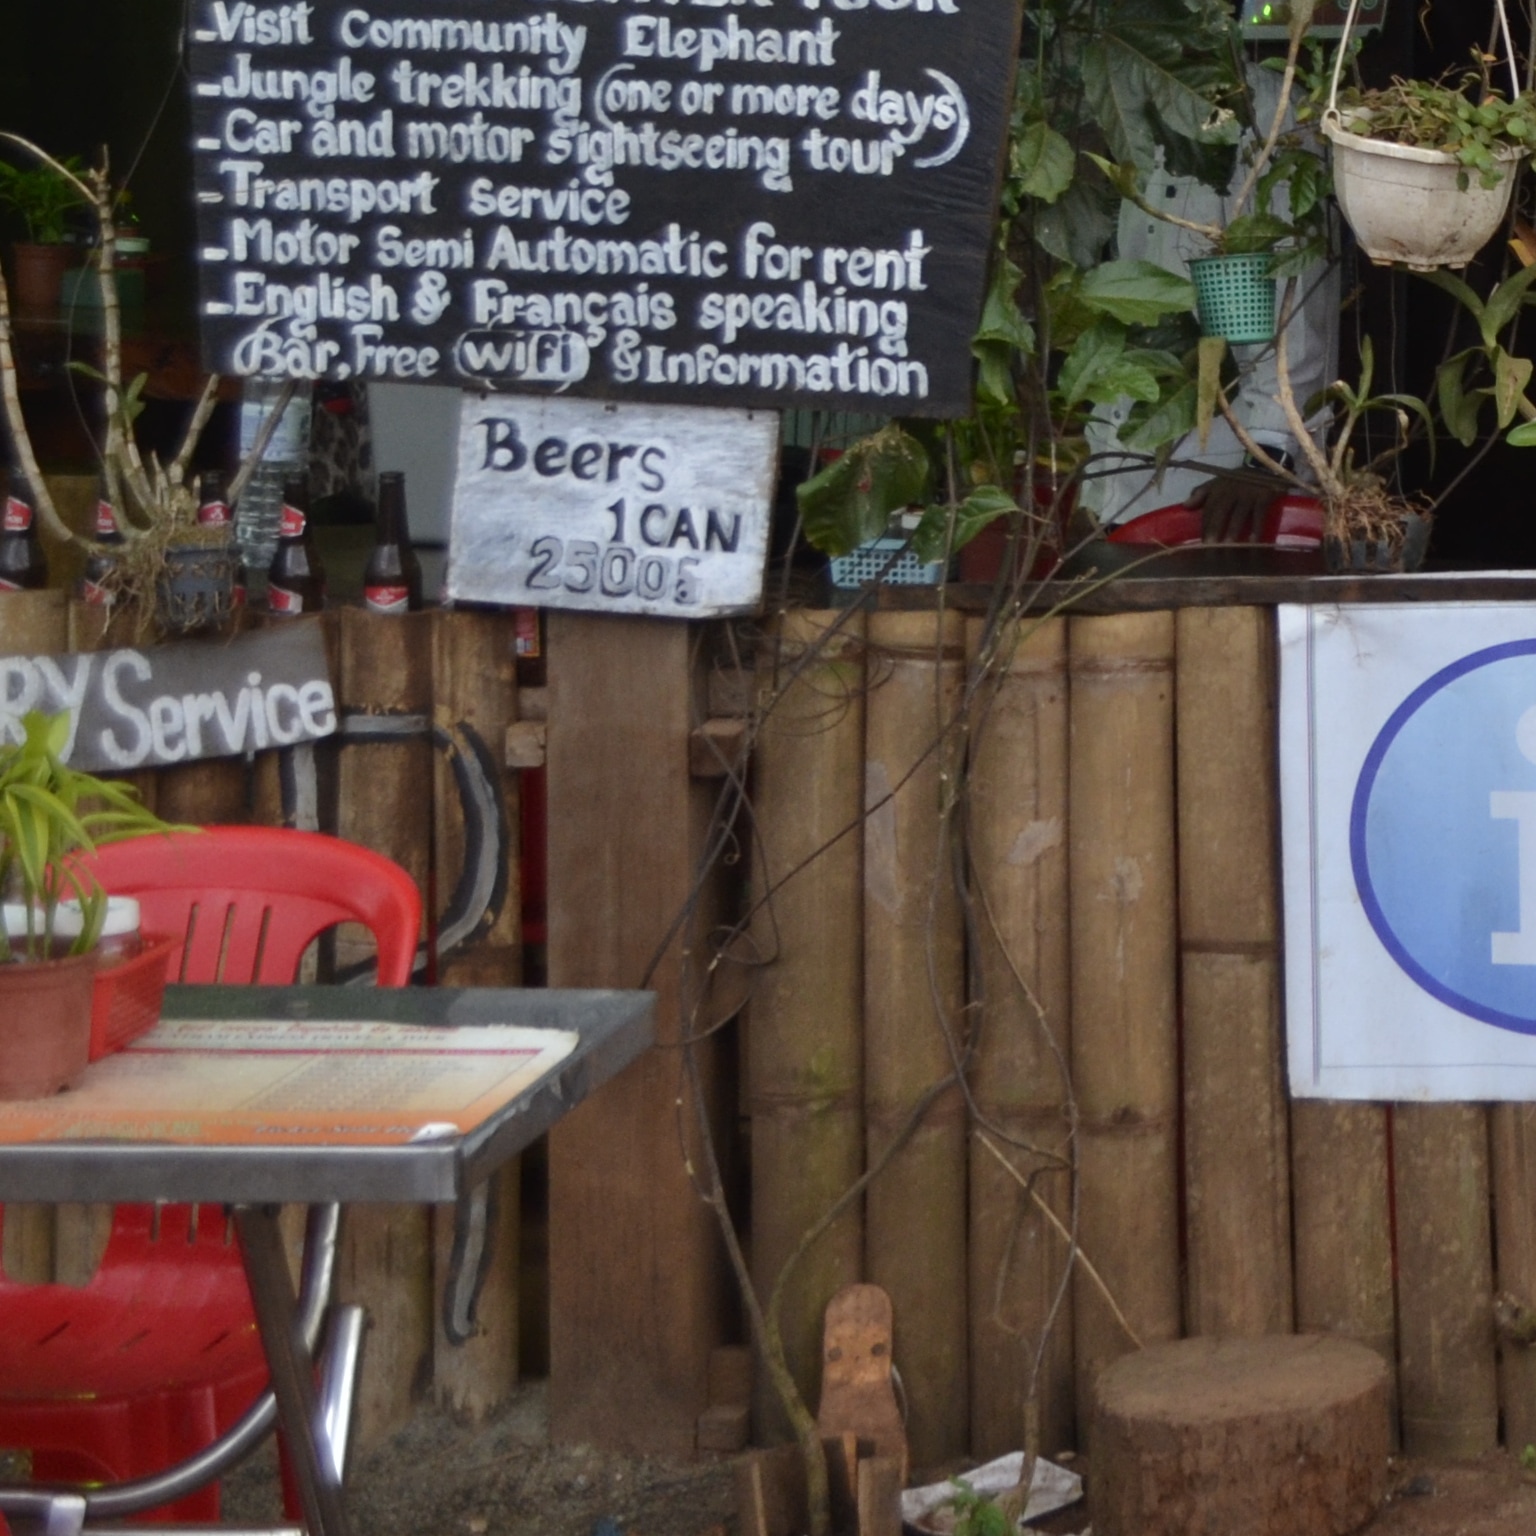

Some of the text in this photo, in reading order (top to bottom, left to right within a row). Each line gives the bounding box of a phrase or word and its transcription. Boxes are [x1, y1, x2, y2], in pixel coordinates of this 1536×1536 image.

[340, 9, 587, 75] Community
[624, 14, 841, 72] Elephant
[393, 60, 582, 128] trekking
[681, 80, 724, 115] or
[731, 82, 840, 120] more
[312, 110, 395, 157] and
[408, 112, 534, 163] motor
[546, 120, 792, 192] sightseeing
[802, 127, 905, 176] tour
[376, 225, 475, 268] Semi
[487, 221, 728, 280] Automatic
[744, 221, 813, 280] for
[822, 229, 933, 291] rent
[412, 270, 451, 325] &
[474, 279, 678, 349] Français
[700, 280, 908, 357] speaking
[352, 324, 440, 377] Free
[645, 342, 929, 399] Information
[475, 417, 667, 493] Beers
[607, 498, 743, 553] 1 CAN
[102, 648, 338, 765] Service
